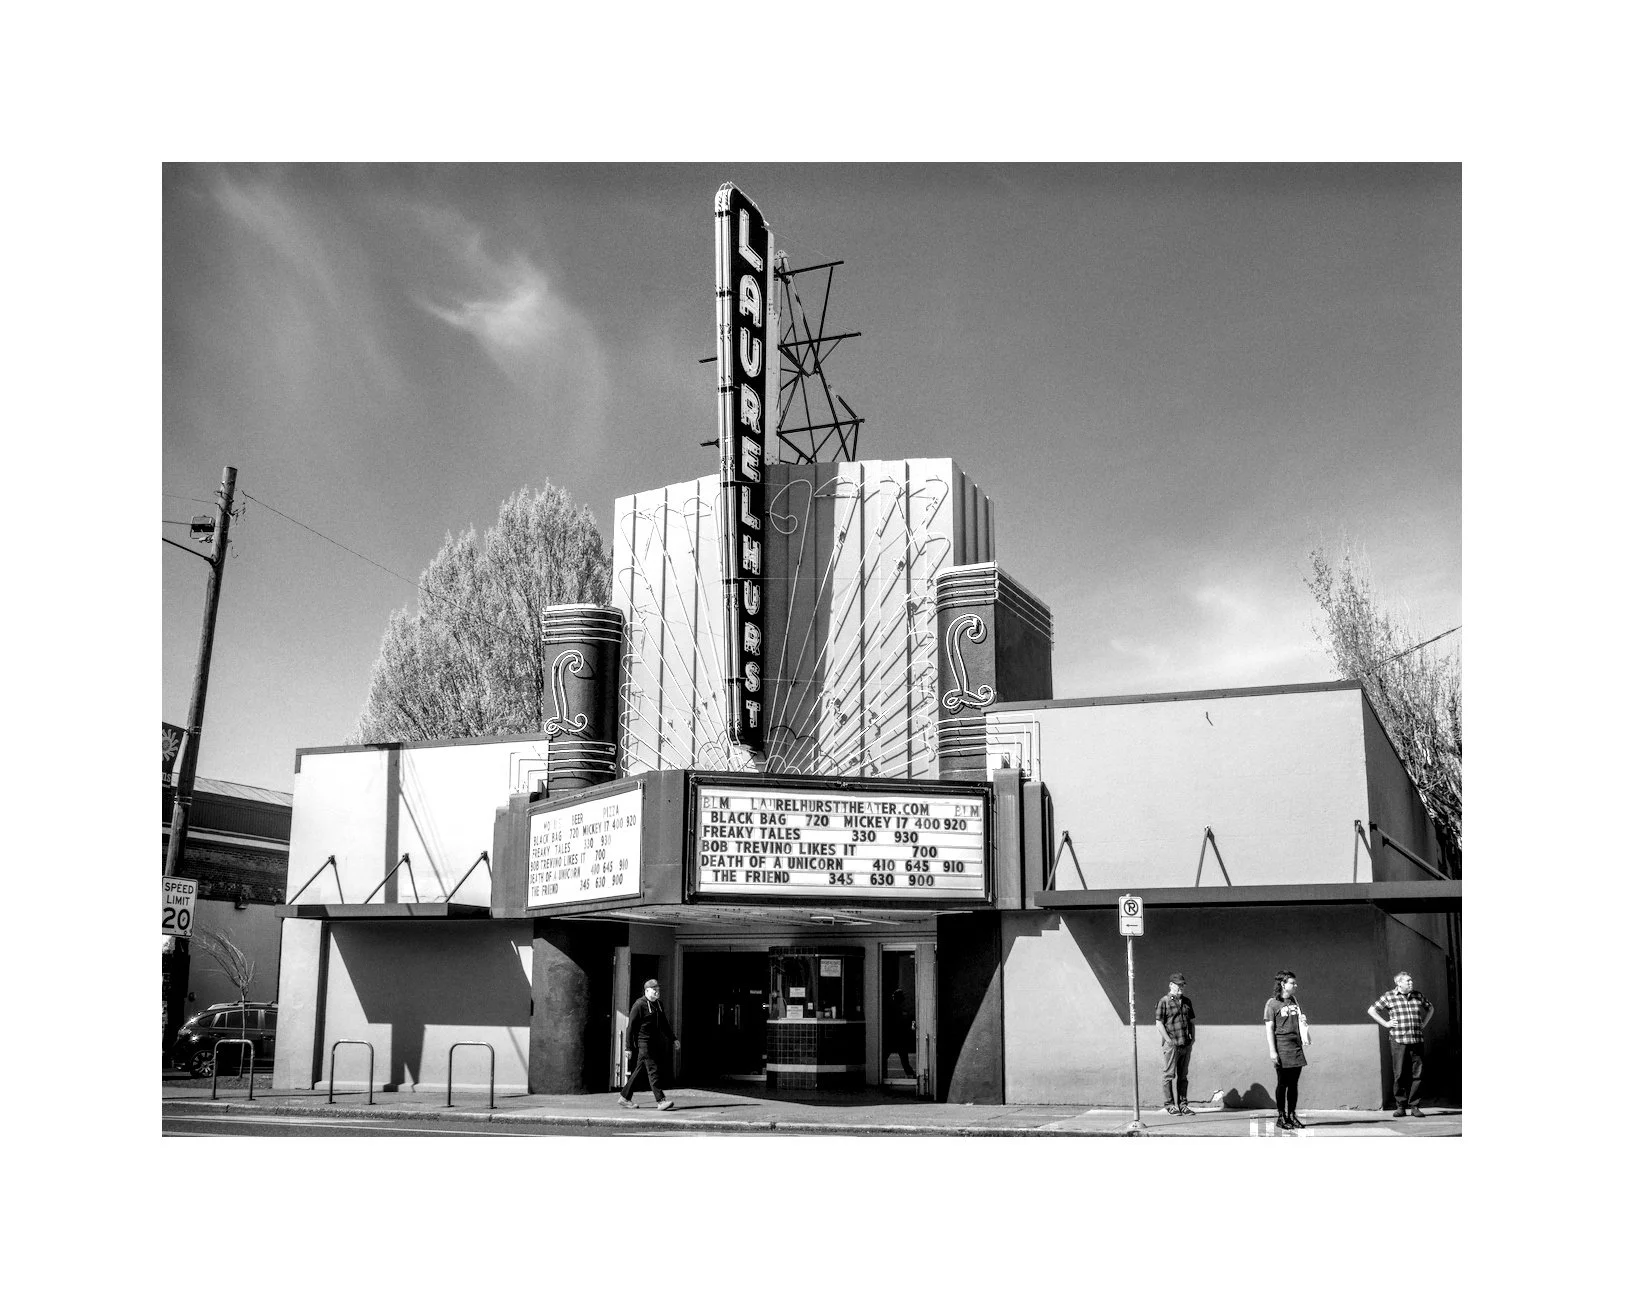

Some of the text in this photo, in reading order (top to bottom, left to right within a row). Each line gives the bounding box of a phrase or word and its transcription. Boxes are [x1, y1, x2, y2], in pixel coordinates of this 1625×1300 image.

[739, 208, 763, 728] LAURELHURST
[572, 813, 583, 825] BEER
[711, 811, 967, 831] BLACK BAG 720 MICKEY 17 400 920
[533, 833, 549, 846] BLACK
[569, 827, 579, 839] 720
[582, 821, 602, 836] MICKEY
[612, 818, 623, 830] 400
[626, 814, 636, 827] 920
[703, 825, 919, 843] FREAKY TALES 330 930
[555, 842, 571, 855] TALES
[601, 834, 611, 846] 930
[702, 840, 937, 858] BOB TREVINO LIKES IT 700
[563, 854, 578, 867] LIKES
[595, 848, 606, 861] 700
[701, 855, 964, 873] DEATH OF A UNICORN 410 645 910
[602, 861, 613, 873] 645
[612, 873, 623, 886] 900
[712, 870, 934, 886] THE FRIEND 345 630 900
[164, 882, 194, 894] SPEED
[166, 894, 190, 906] LIMIT
[162, 907, 190, 930] 20
